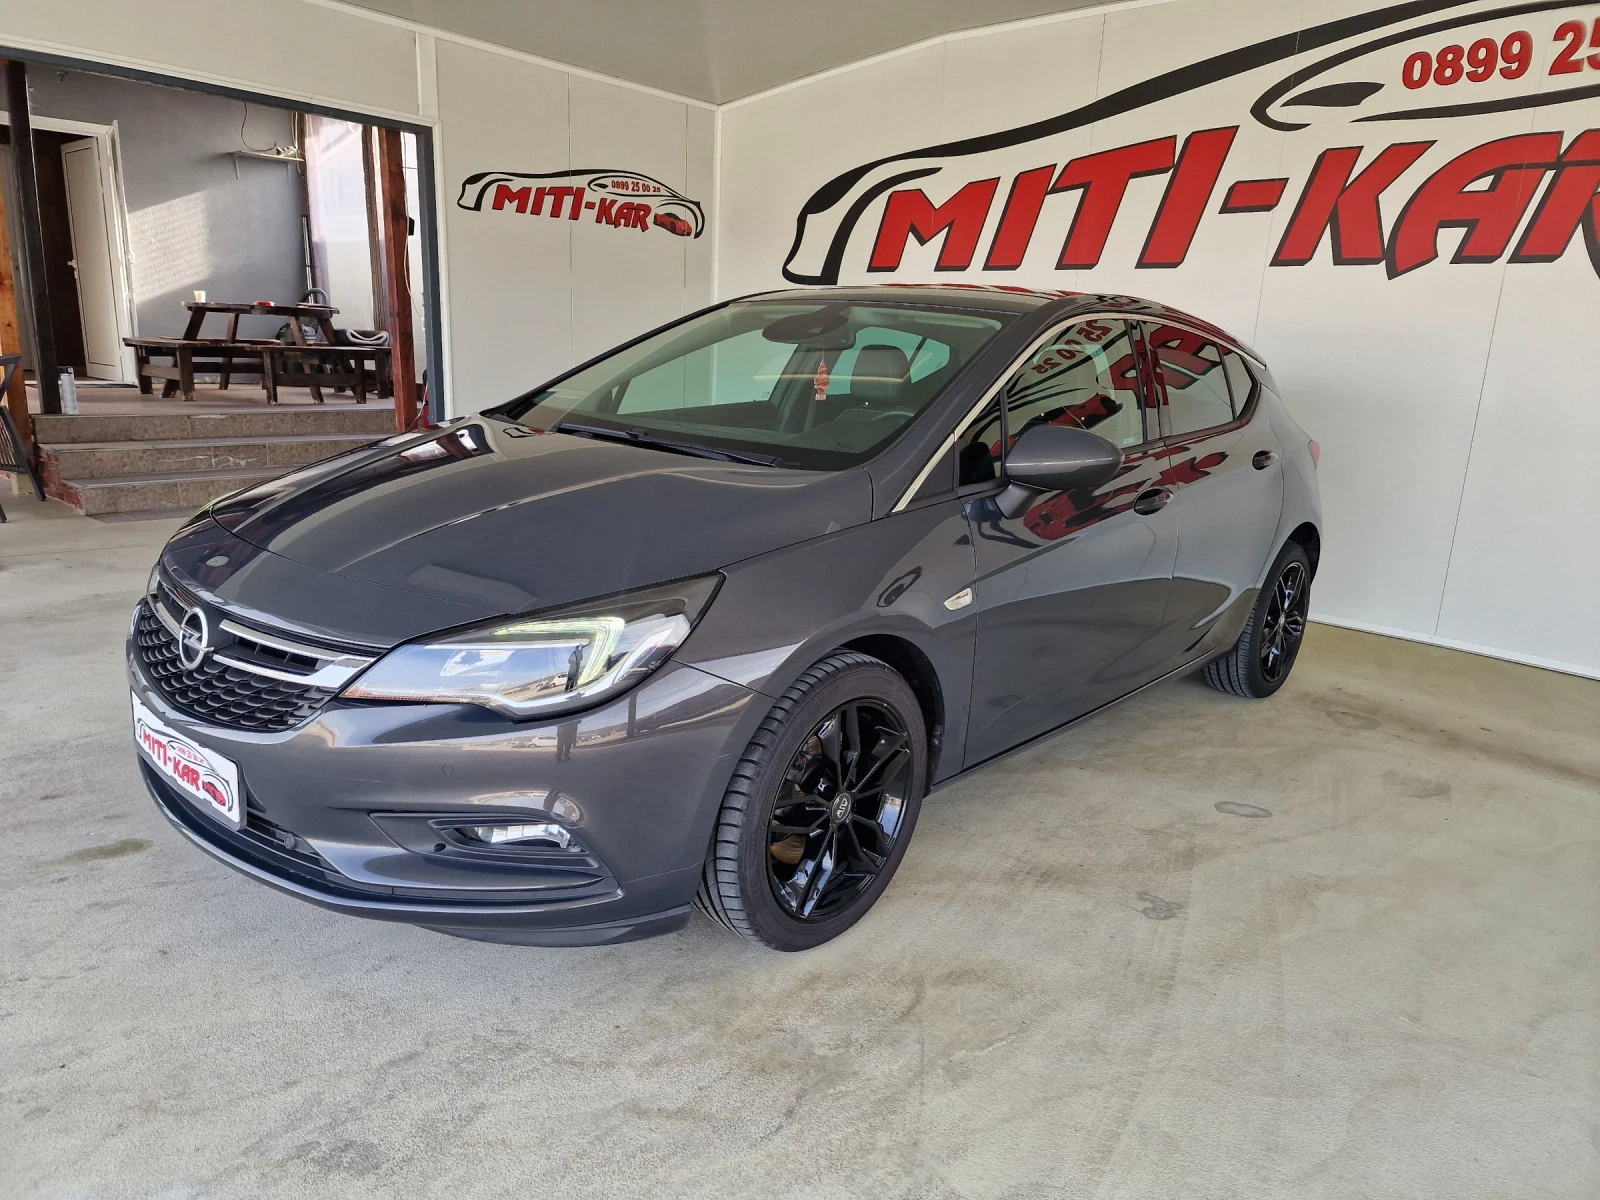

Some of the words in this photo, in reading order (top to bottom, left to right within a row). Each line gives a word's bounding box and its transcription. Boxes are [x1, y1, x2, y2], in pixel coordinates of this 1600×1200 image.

[1402, 30, 1533, 90] 0899
[492, 184, 652, 232] MITI-KAR
[611, 180, 629, 191] 0899
[631, 181, 640, 192] 25
[642, 183, 650, 192] 00
[143, 727, 201, 791] MITI-KAR
